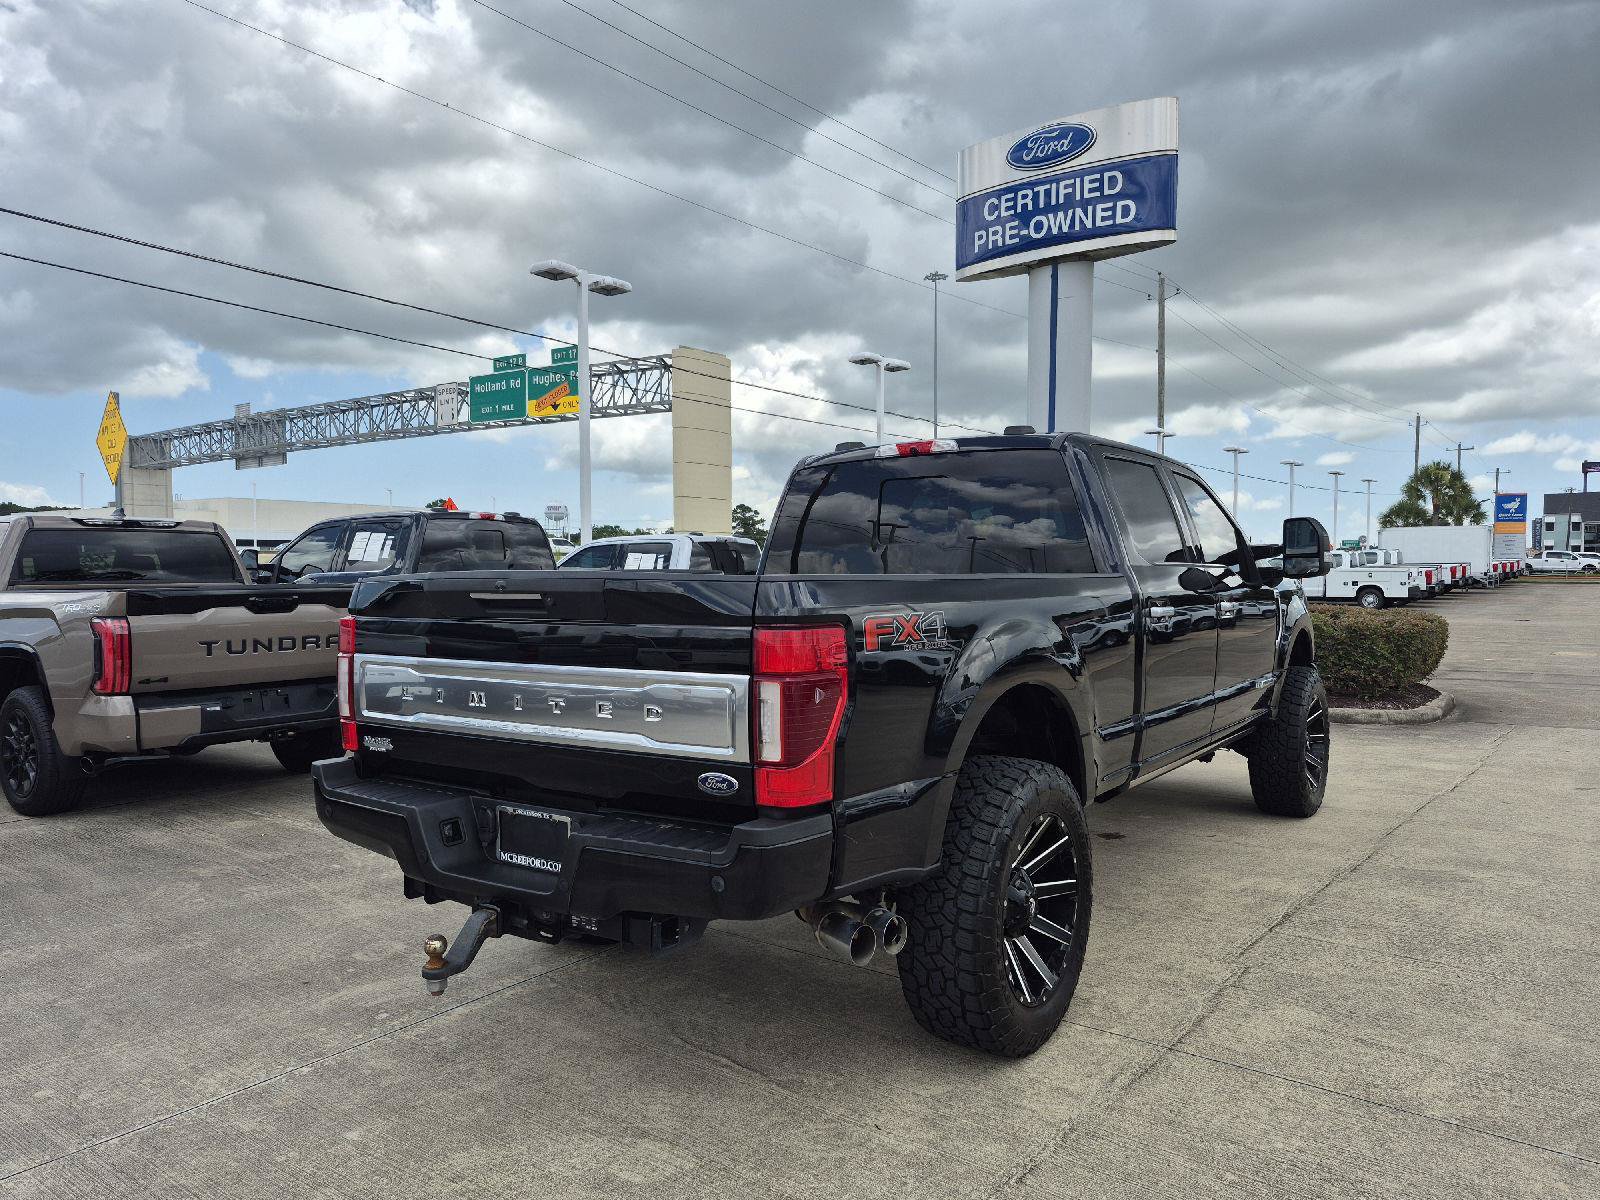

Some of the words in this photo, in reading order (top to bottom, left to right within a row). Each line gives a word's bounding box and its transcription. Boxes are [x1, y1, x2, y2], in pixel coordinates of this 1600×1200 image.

[1022, 129, 1074, 161] Ford
[983, 171, 1123, 221] CERTIFIED
[974, 199, 1137, 254] PRE-OWNED
[554, 351, 566, 360] EXIT
[474, 379, 506, 393] Holland
[510, 377, 521, 389] Rd
[532, 372, 566, 386] Hughes
[438, 387, 456, 396] SPEED
[481, 406, 493, 414] EXIT
[501, 403, 515, 411] MILE
[863, 610, 947, 654] FX4
[198, 633, 340, 657] TUNDRA
[401, 686, 663, 721] LIMITED
